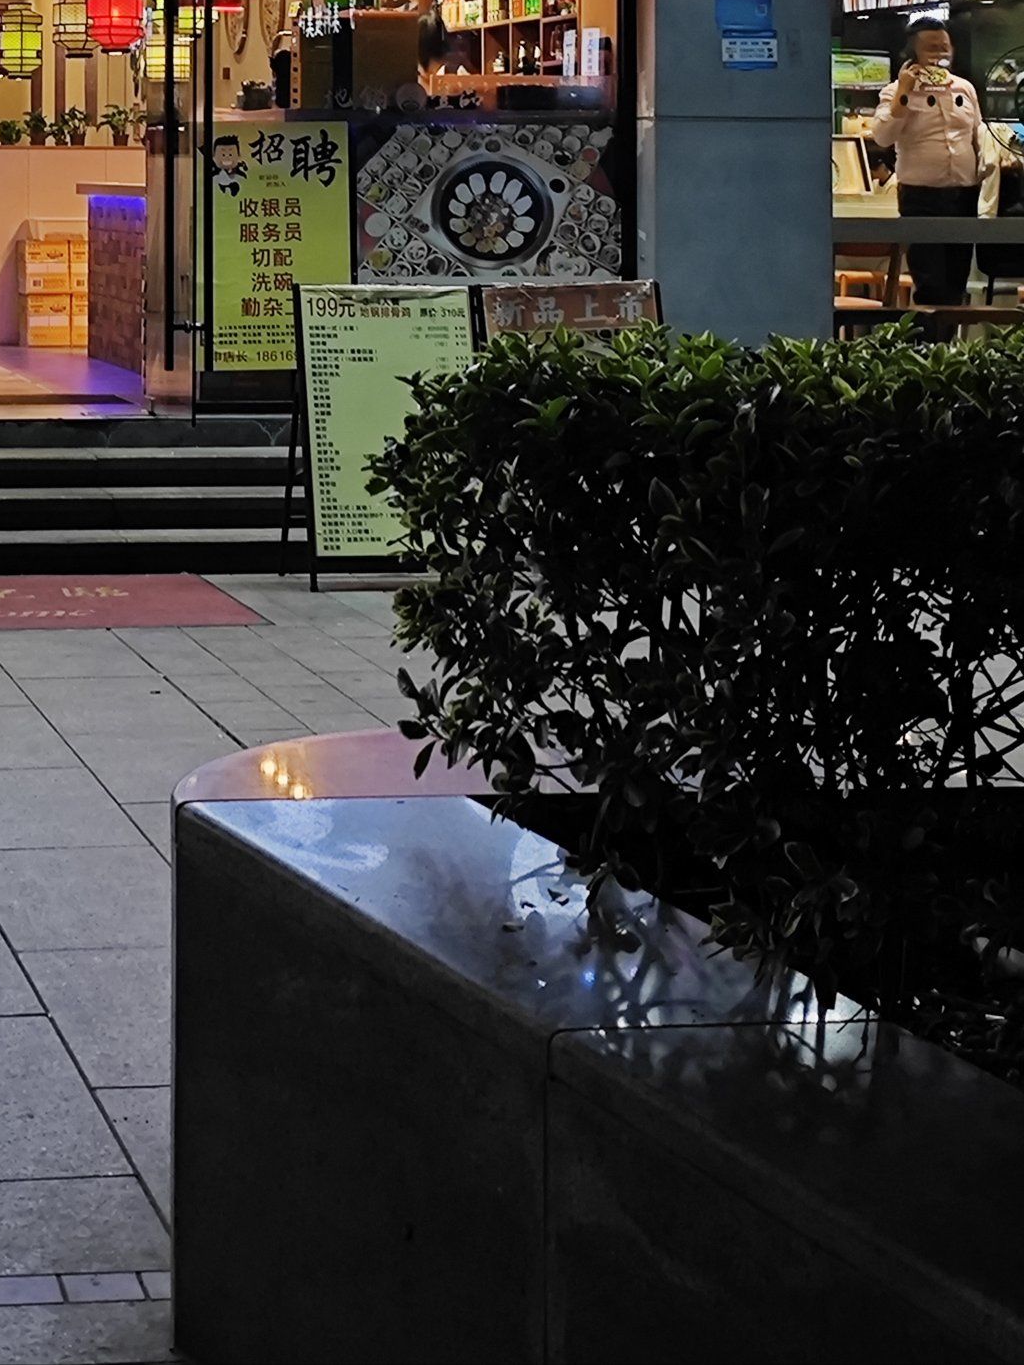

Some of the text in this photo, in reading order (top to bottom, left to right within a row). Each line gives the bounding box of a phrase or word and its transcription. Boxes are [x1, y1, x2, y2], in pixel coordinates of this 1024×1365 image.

[248, 129, 343, 188] 招聘
[239, 198, 303, 218] 收银员
[239, 223, 303, 243] 服务员
[251, 248, 294, 267] 切配
[251, 273, 294, 292] 洗碗
[307, 297, 356, 318] 199元
[491, 291, 647, 327] 新品上市
